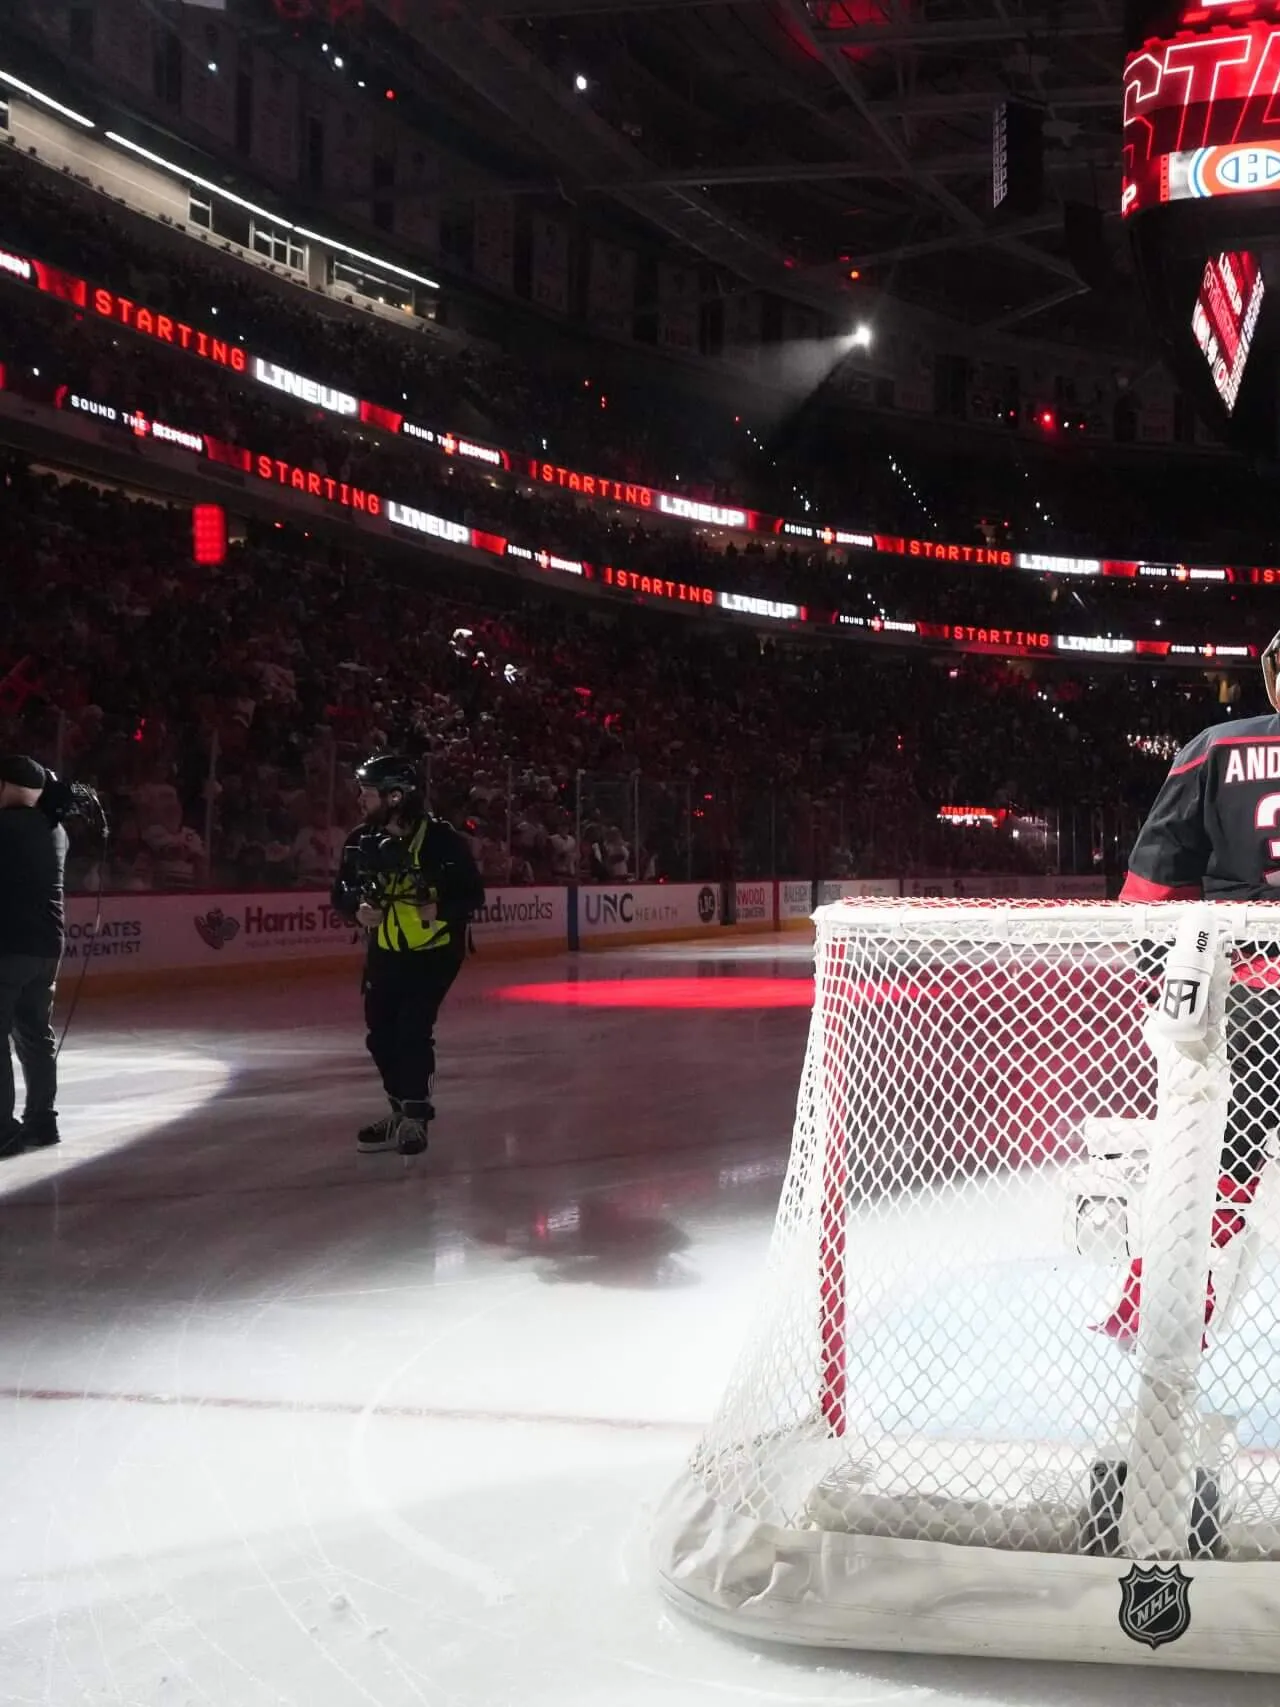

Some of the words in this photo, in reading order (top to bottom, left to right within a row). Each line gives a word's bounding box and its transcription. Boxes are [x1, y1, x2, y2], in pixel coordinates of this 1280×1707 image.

[96, 288, 246, 371] STARTING
[256, 358, 357, 415] LINEUP
[71, 394, 116, 420] SOUND
[258, 455, 380, 515] STARTING
[388, 500, 470, 544] LINEUP
[542, 464, 652, 506] STARTING
[660, 495, 745, 526] LINEUP
[909, 540, 1012, 566] STARTING
[1020, 553, 1099, 574] LINEUP
[617, 568, 713, 605] STARTING
[721, 592, 798, 619] LINEUP
[954, 626, 1050, 647] STARTING
[1058, 635, 1134, 653] LINEUP
[245, 905, 316, 934] Harris
[585, 893, 634, 924] UNC
[634, 906, 678, 920] HEALTH
[83, 940, 141, 957] DENTIST
[1136, 1587, 1176, 1627] NHL
